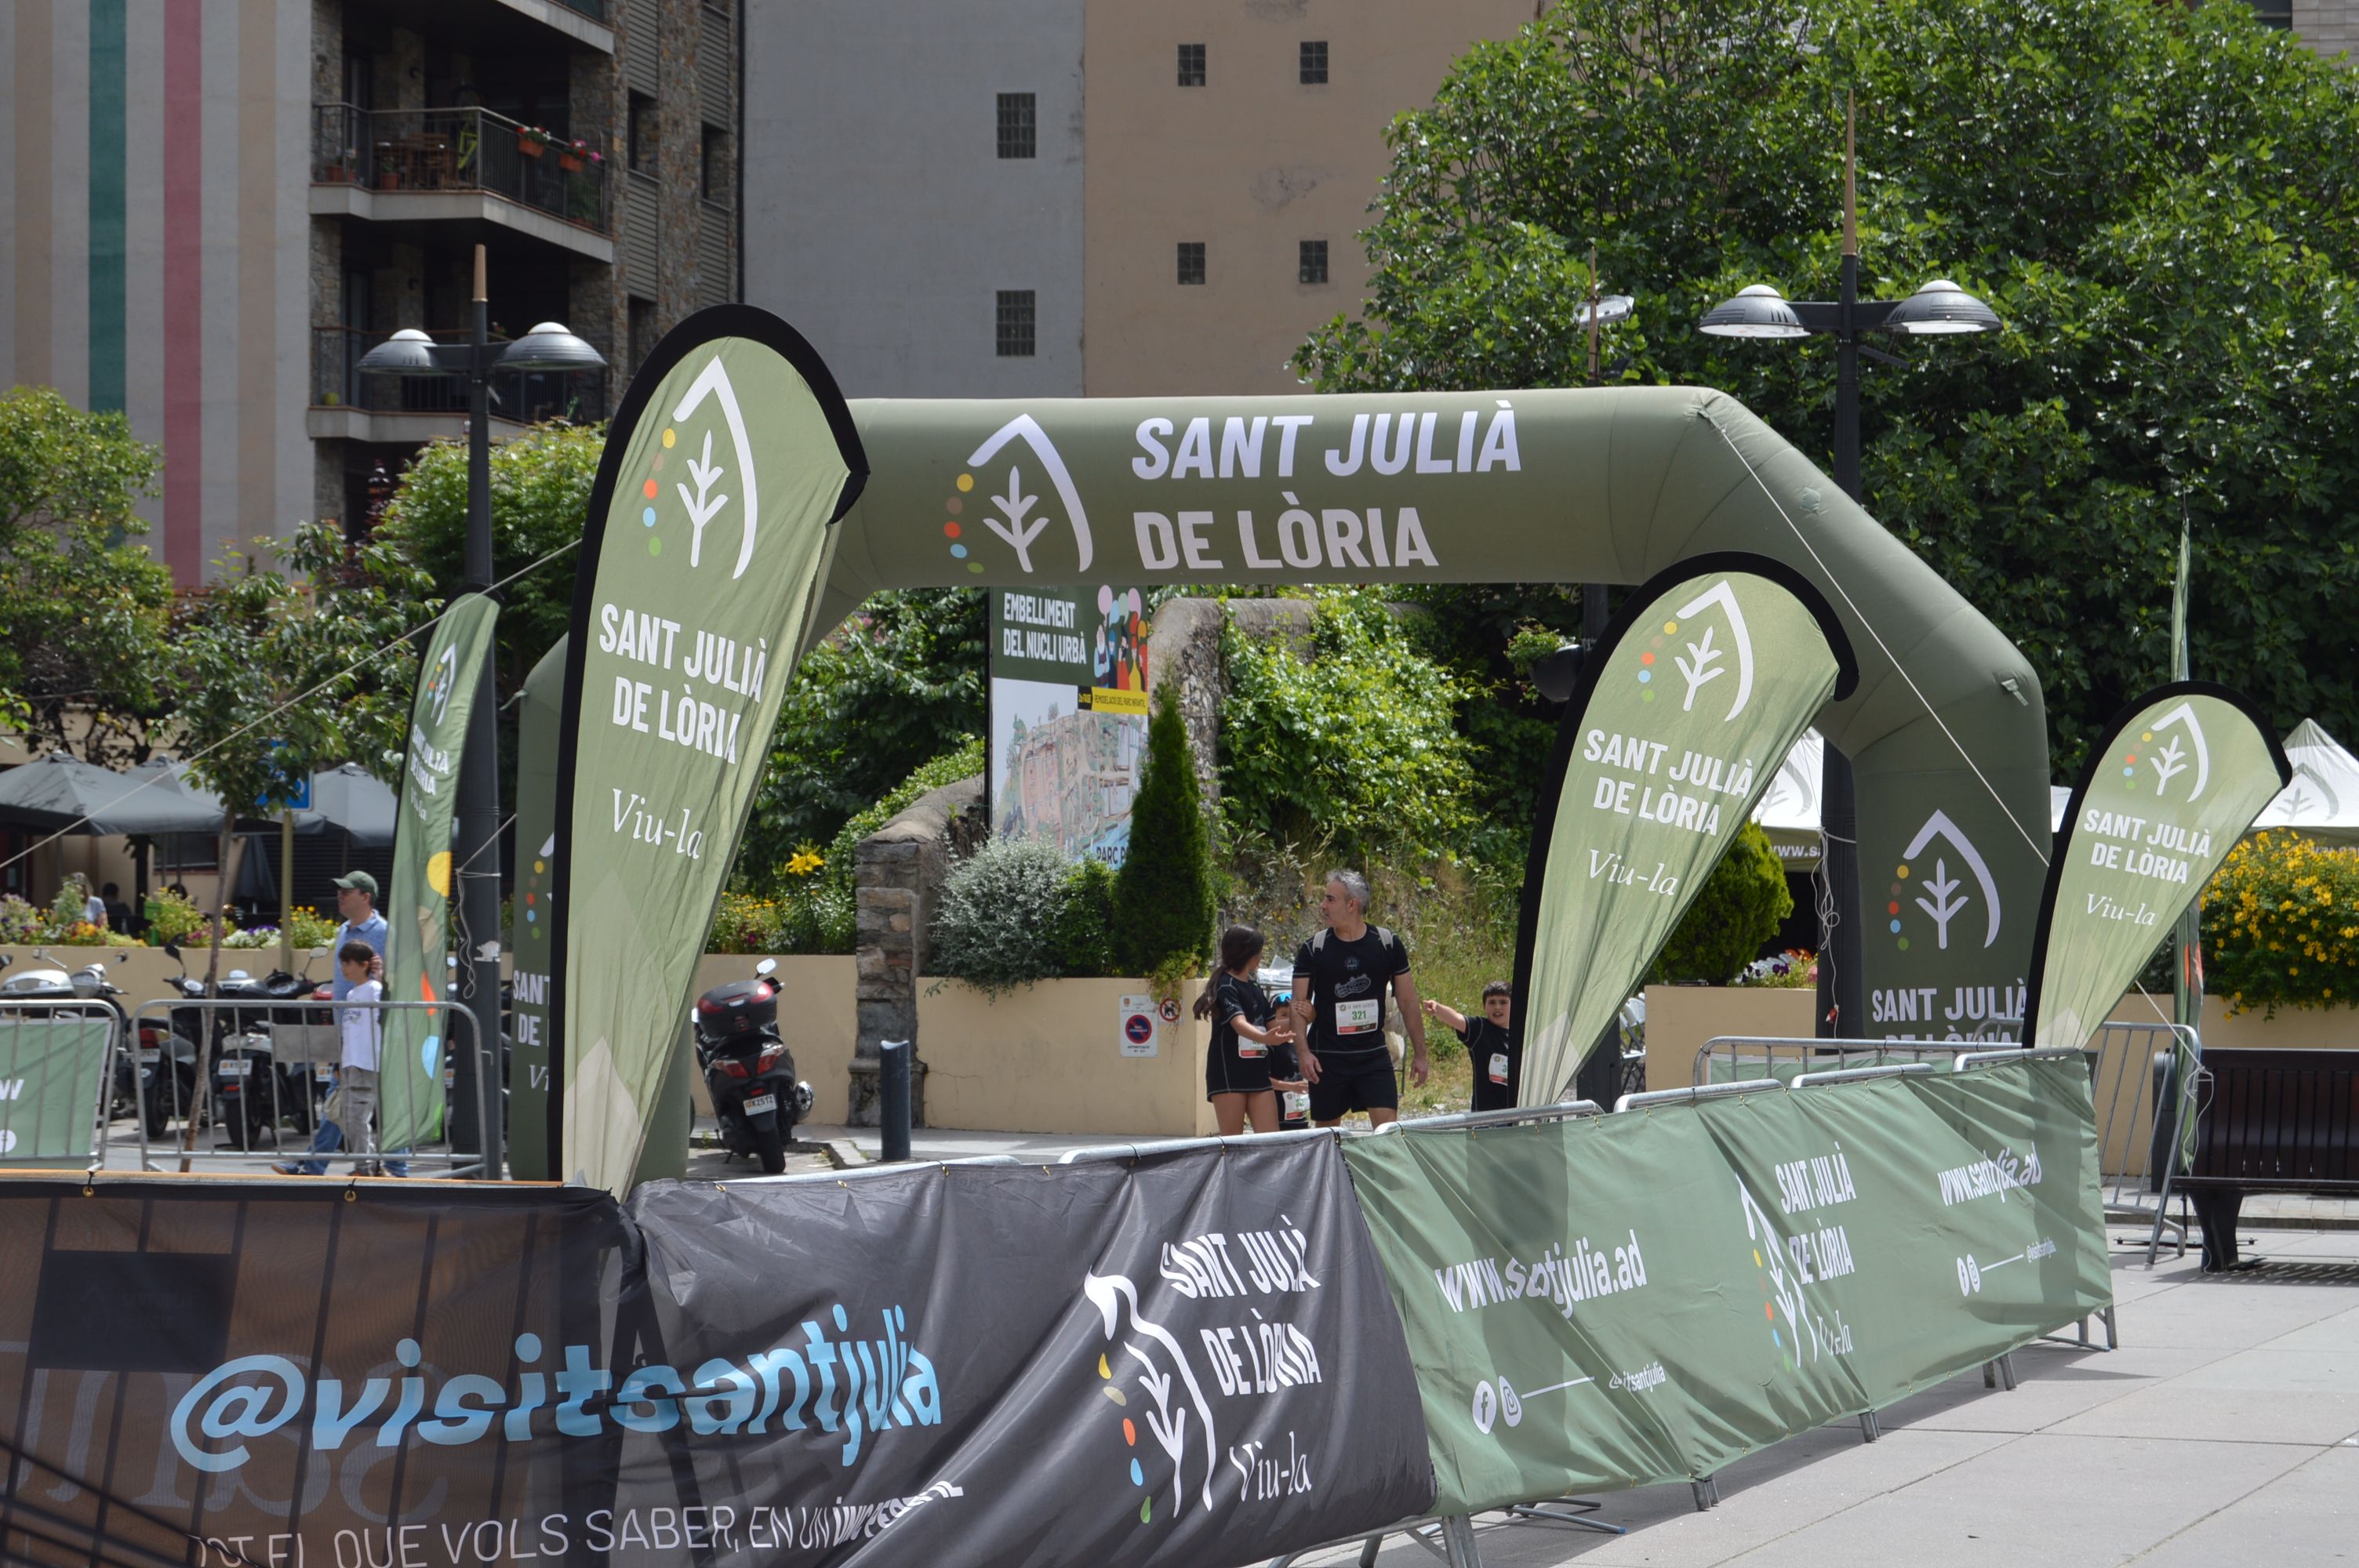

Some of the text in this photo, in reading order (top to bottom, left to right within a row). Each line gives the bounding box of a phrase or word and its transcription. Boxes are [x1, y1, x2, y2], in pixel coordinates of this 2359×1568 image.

[1132, 400, 1521, 480] SANT JULIÀ
[1132, 491, 1439, 570] DE LÒRIA
[1004, 592, 1075, 629] EMBELLIMENT
[599, 603, 766, 702] SANT JULIÀ
[1003, 628, 1087, 664] DEL NUCLI URBÀ
[612, 677, 740, 764] DE LÒRIA
[1583, 729, 1753, 799] SANT JULIÀ
[612, 788, 703, 859] Viu-la
[1593, 776, 1720, 836] DE LÒRIA
[2084, 809, 2210, 858] SANT JULIÀ
[1096, 846, 1118, 864] PARC
[1590, 849, 1678, 896] Viu-la
[2090, 842, 2188, 884] DE LÒRIA
[2086, 893, 2157, 926] Viu-la
[518, 1013, 541, 1046] DE
[1351, 1011, 1366, 1021] 321
[1872, 978, 2027, 1022] SANT JULIÀ
[1775, 1142, 1856, 1214] SANT JULIÀ
[1159, 1233, 1248, 1298] SANT
[1788, 1218, 1855, 1284] DE LÒRIA
[1200, 1308, 1322, 1396] DE LÒRIA
[170, 1304, 941, 1472] @visitsantjulia
[1229, 1432, 1312, 1501] Viu-la
[441, 1514, 569, 1564] VOLS
[586, 1506, 739, 1553] SABER,
[749, 1506, 793, 1548] EN
[799, 1506, 829, 1549] UN
